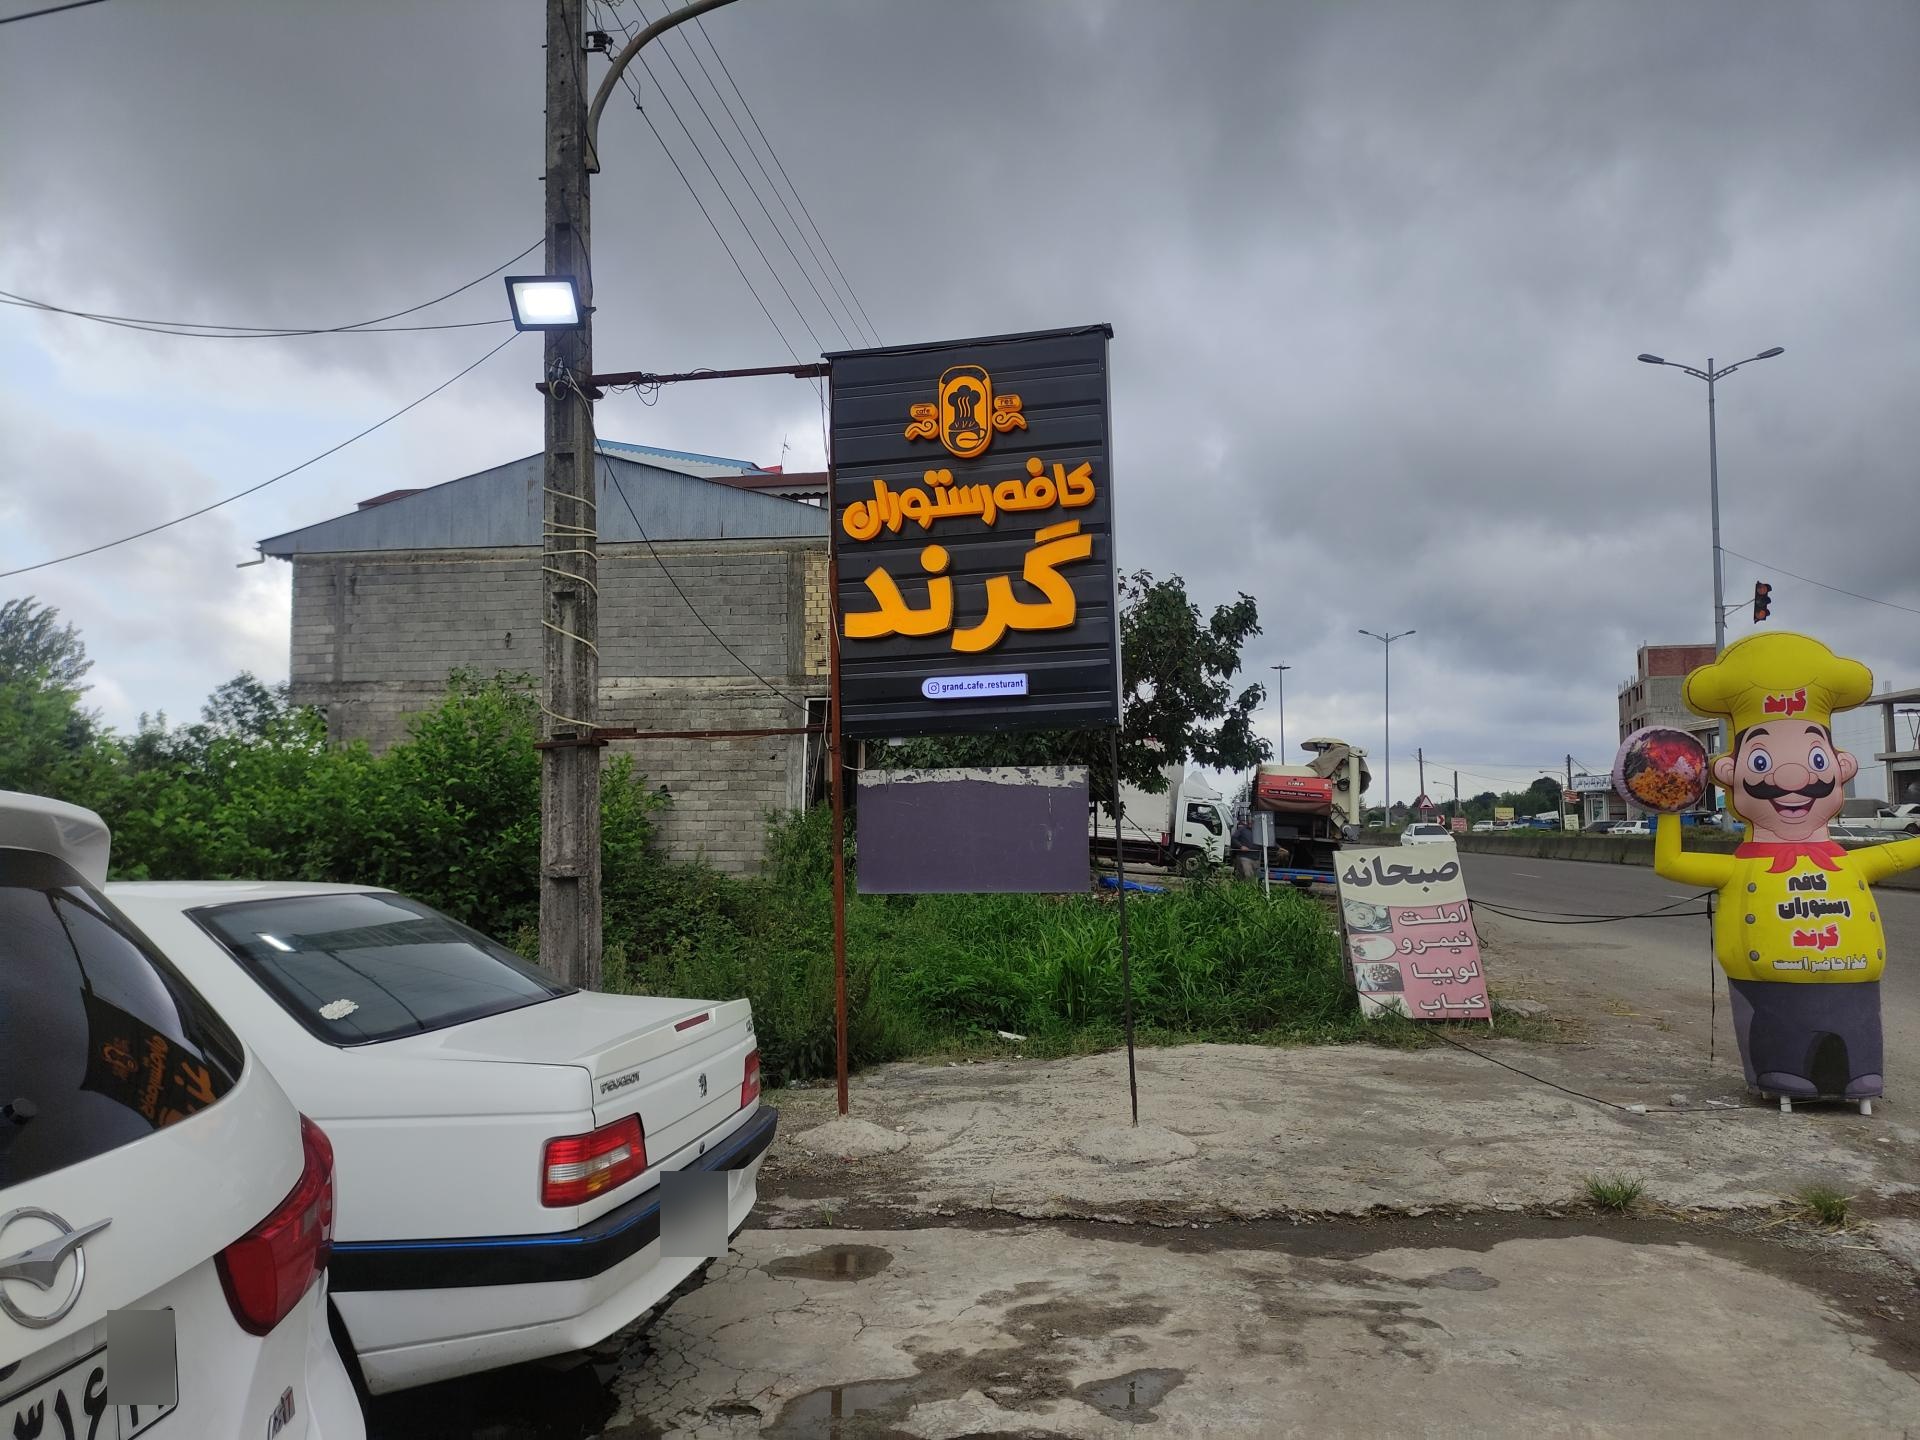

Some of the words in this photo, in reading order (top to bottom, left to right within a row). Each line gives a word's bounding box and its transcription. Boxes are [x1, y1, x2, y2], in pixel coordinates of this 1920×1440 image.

[993, 457, 1096, 512] کافه
[842, 468, 997, 541] رستوران
[844, 519, 1093, 652] گرند
[1763, 687, 1807, 717] گرند
[1342, 855, 1459, 893] صبحانه
[1788, 872, 1827, 891] کافه
[1398, 904, 1467, 925] املت
[1777, 896, 1852, 919] رستوران
[1397, 931, 1473, 955] نیمرو
[1792, 923, 1840, 951] گرند
[1410, 960, 1480, 985] لوبیا
[1772, 955, 1810, 971] است
[1810, 955, 1846, 974] حاضر
[1846, 952, 1868, 971] غذا
[1419, 993, 1486, 1016] کباب
